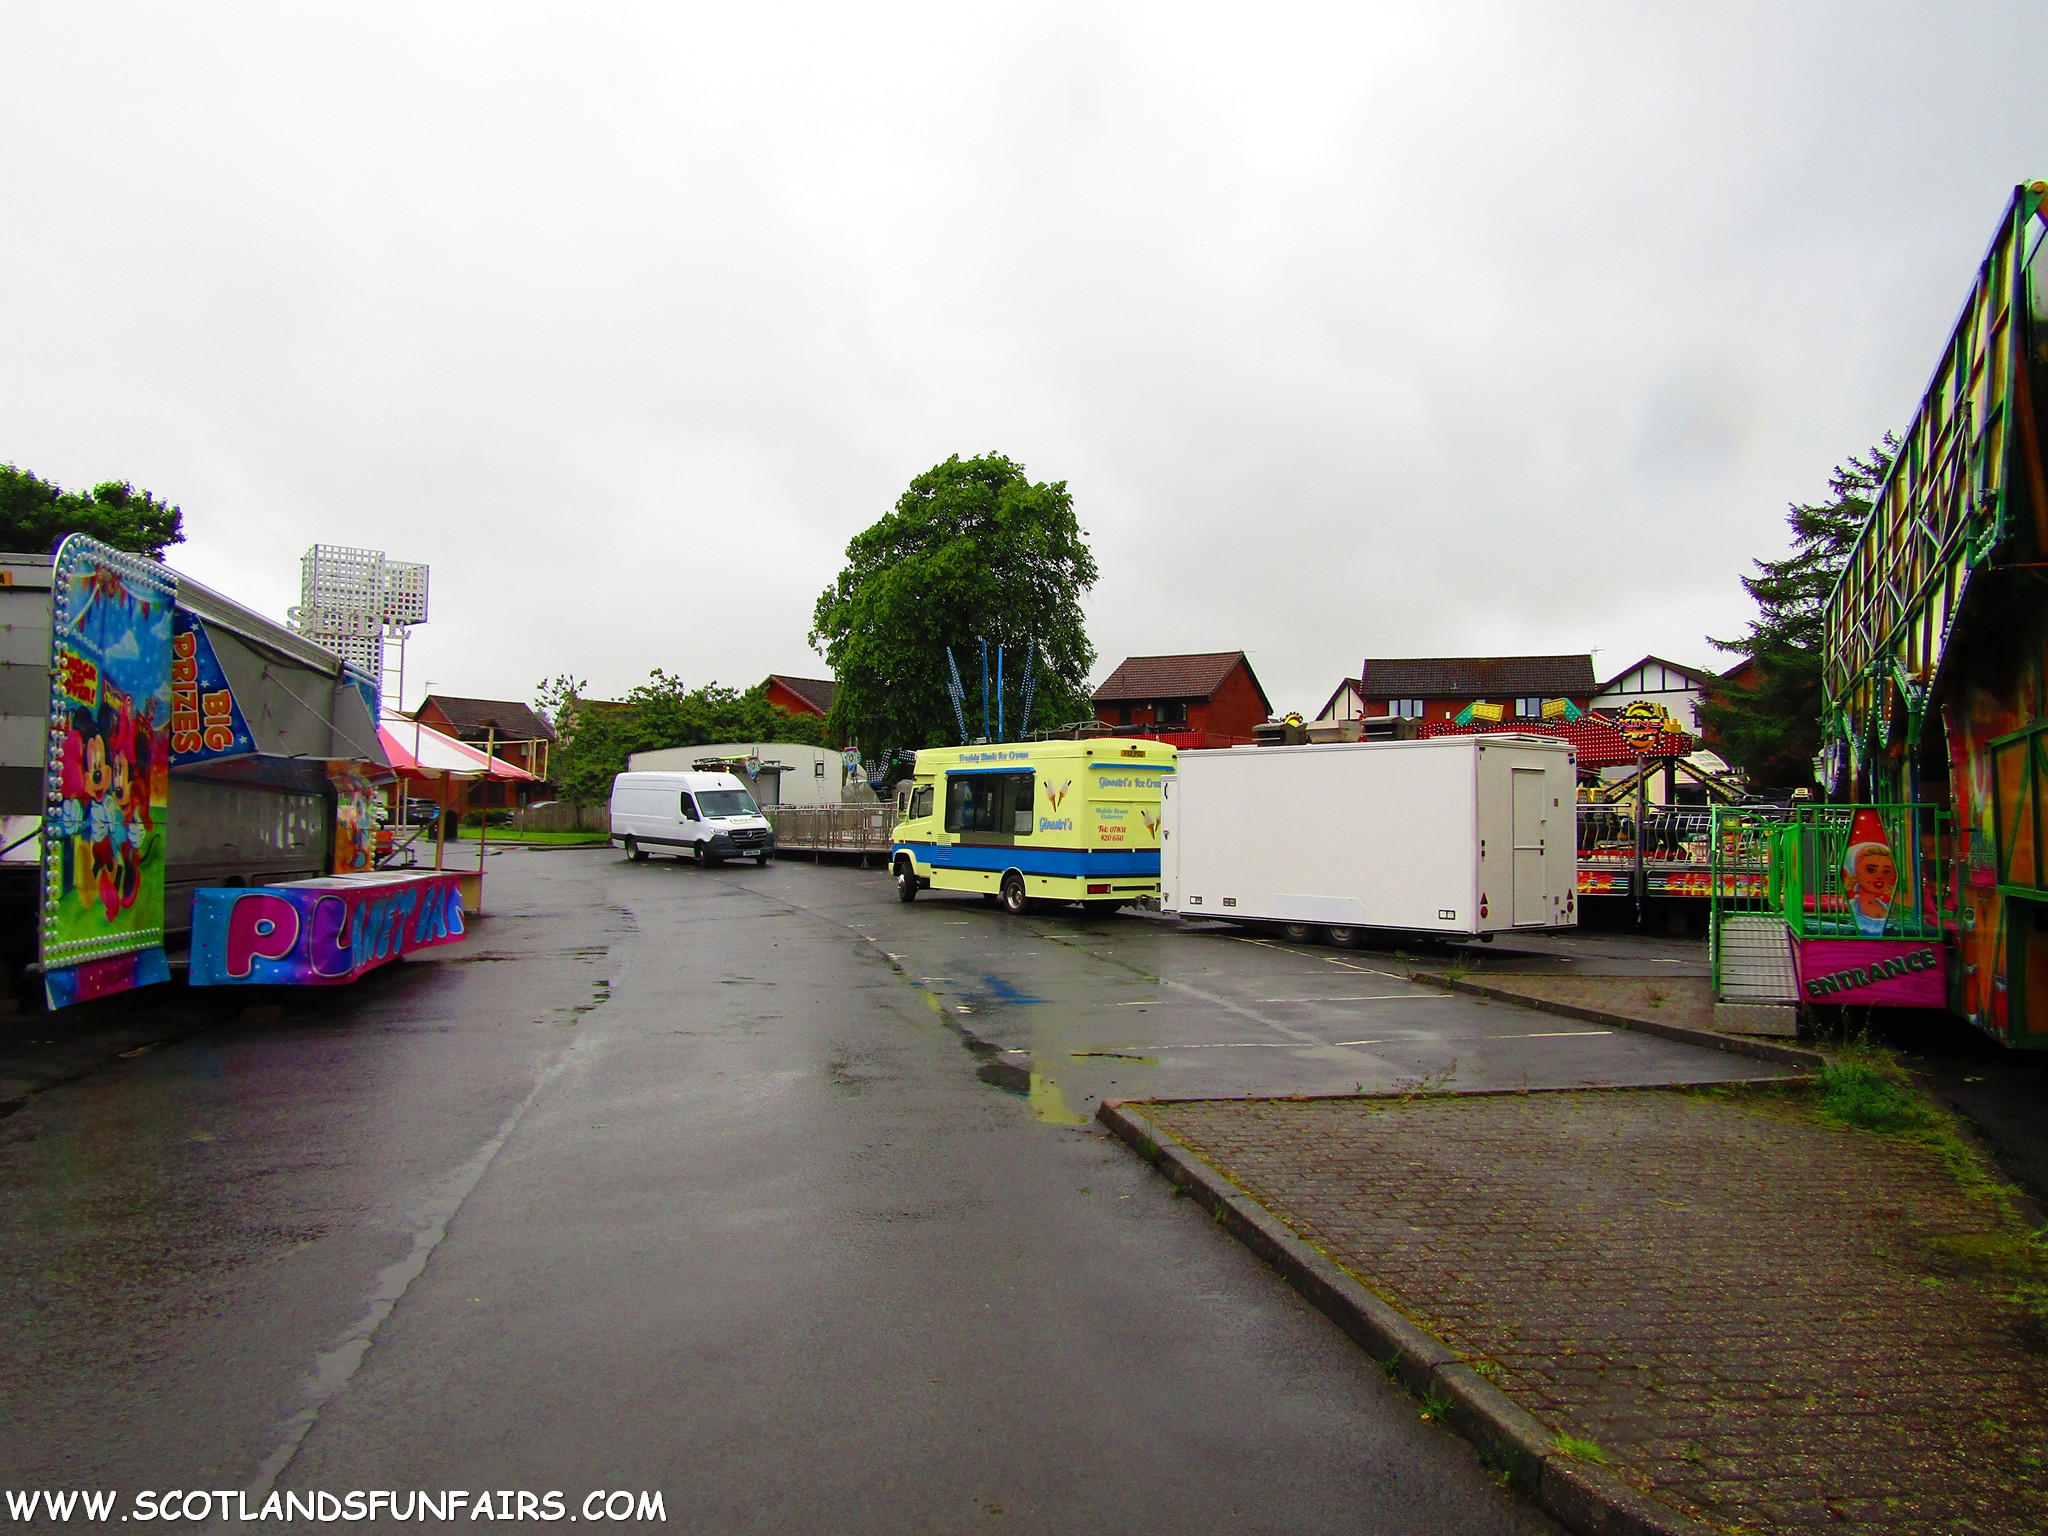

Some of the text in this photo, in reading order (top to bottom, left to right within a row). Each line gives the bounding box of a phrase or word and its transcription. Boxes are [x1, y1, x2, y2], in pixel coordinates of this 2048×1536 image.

[172, 631, 203, 754] PRIZES
[202, 689, 234, 752] BIG
[1619, 718, 1661, 728] KING
[1134, 777, 1146, 788] Ice
[1098, 825, 1109, 834] Tel:
[1100, 834, 1124, 842] 420 650
[226, 885, 418, 977] PLANET
[1804, 948, 1937, 997] ENTRANCE
